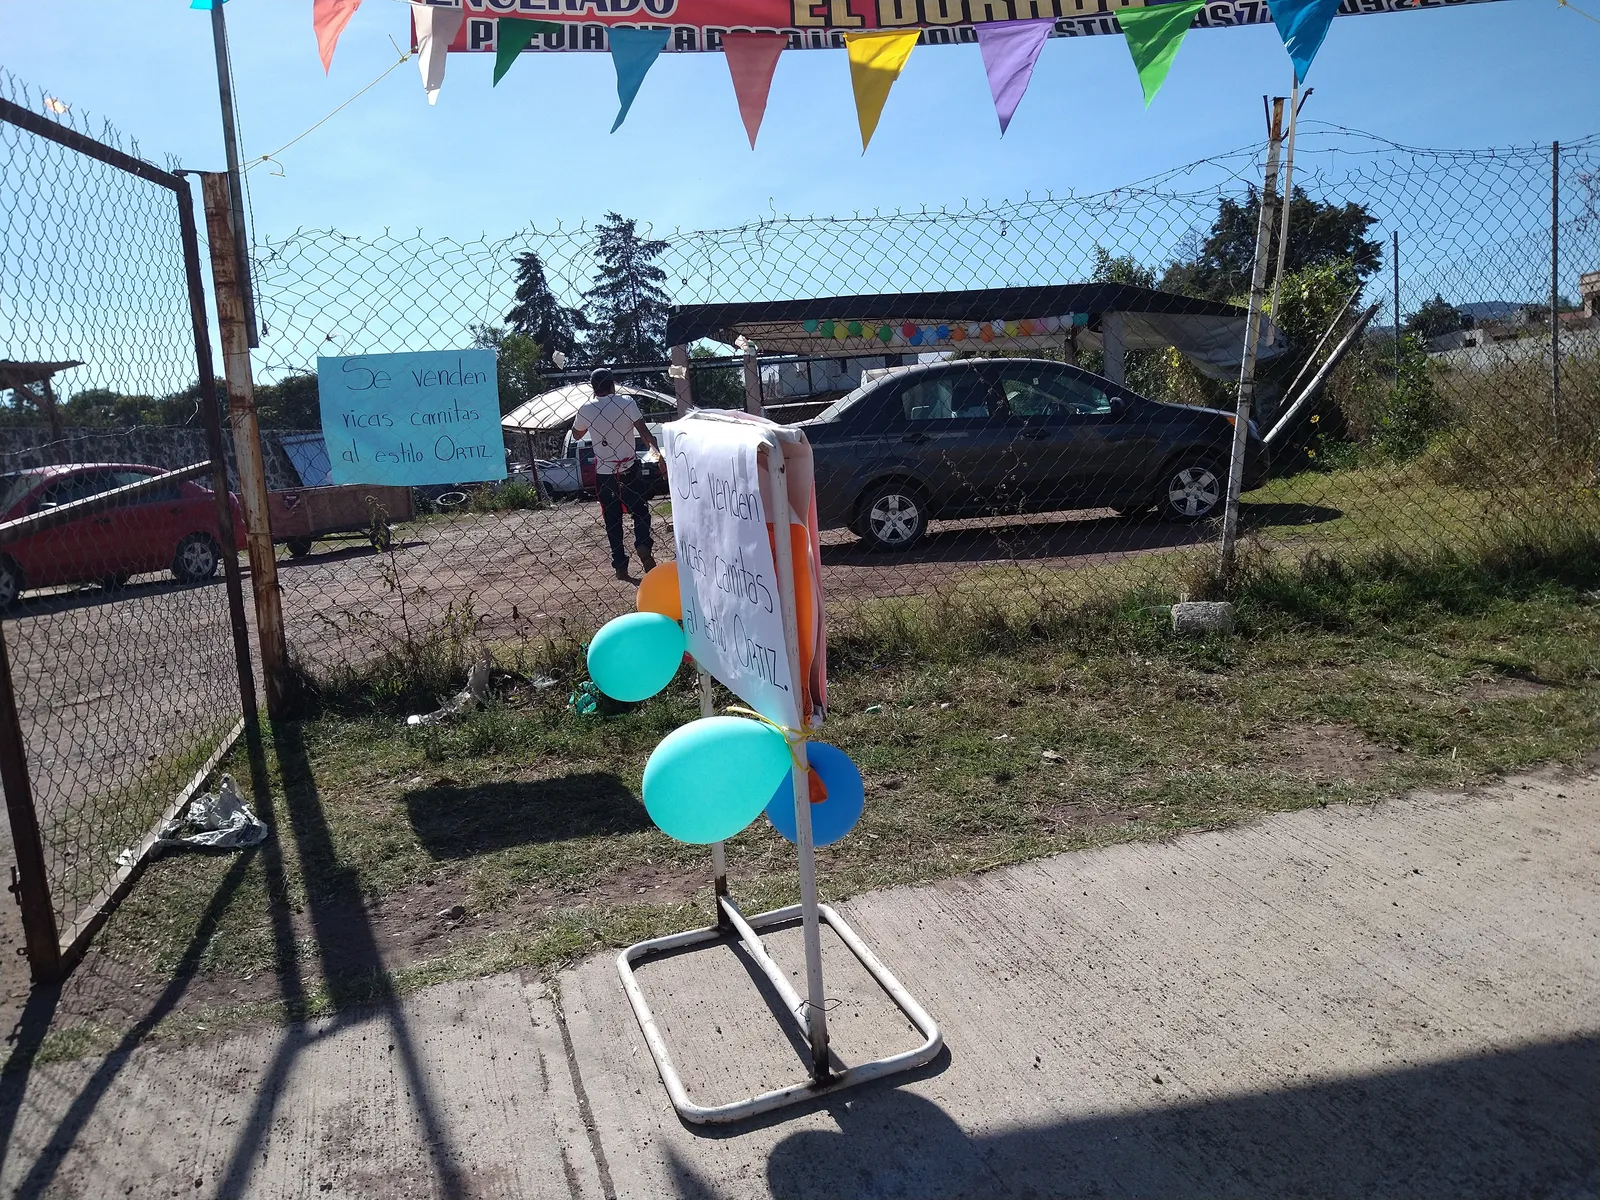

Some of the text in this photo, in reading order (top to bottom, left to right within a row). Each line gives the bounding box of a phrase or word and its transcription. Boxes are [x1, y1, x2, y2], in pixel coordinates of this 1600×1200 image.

[342, 357, 487, 391] Se venden
[342, 398, 480, 428] ricas carnitas
[341, 438, 360, 463] al
[375, 442, 424, 464] estilo
[674, 431, 700, 500] Se
[714, 546, 774, 614] carnitas
[686, 596, 699, 635] al
[703, 598, 727, 653] estilo
